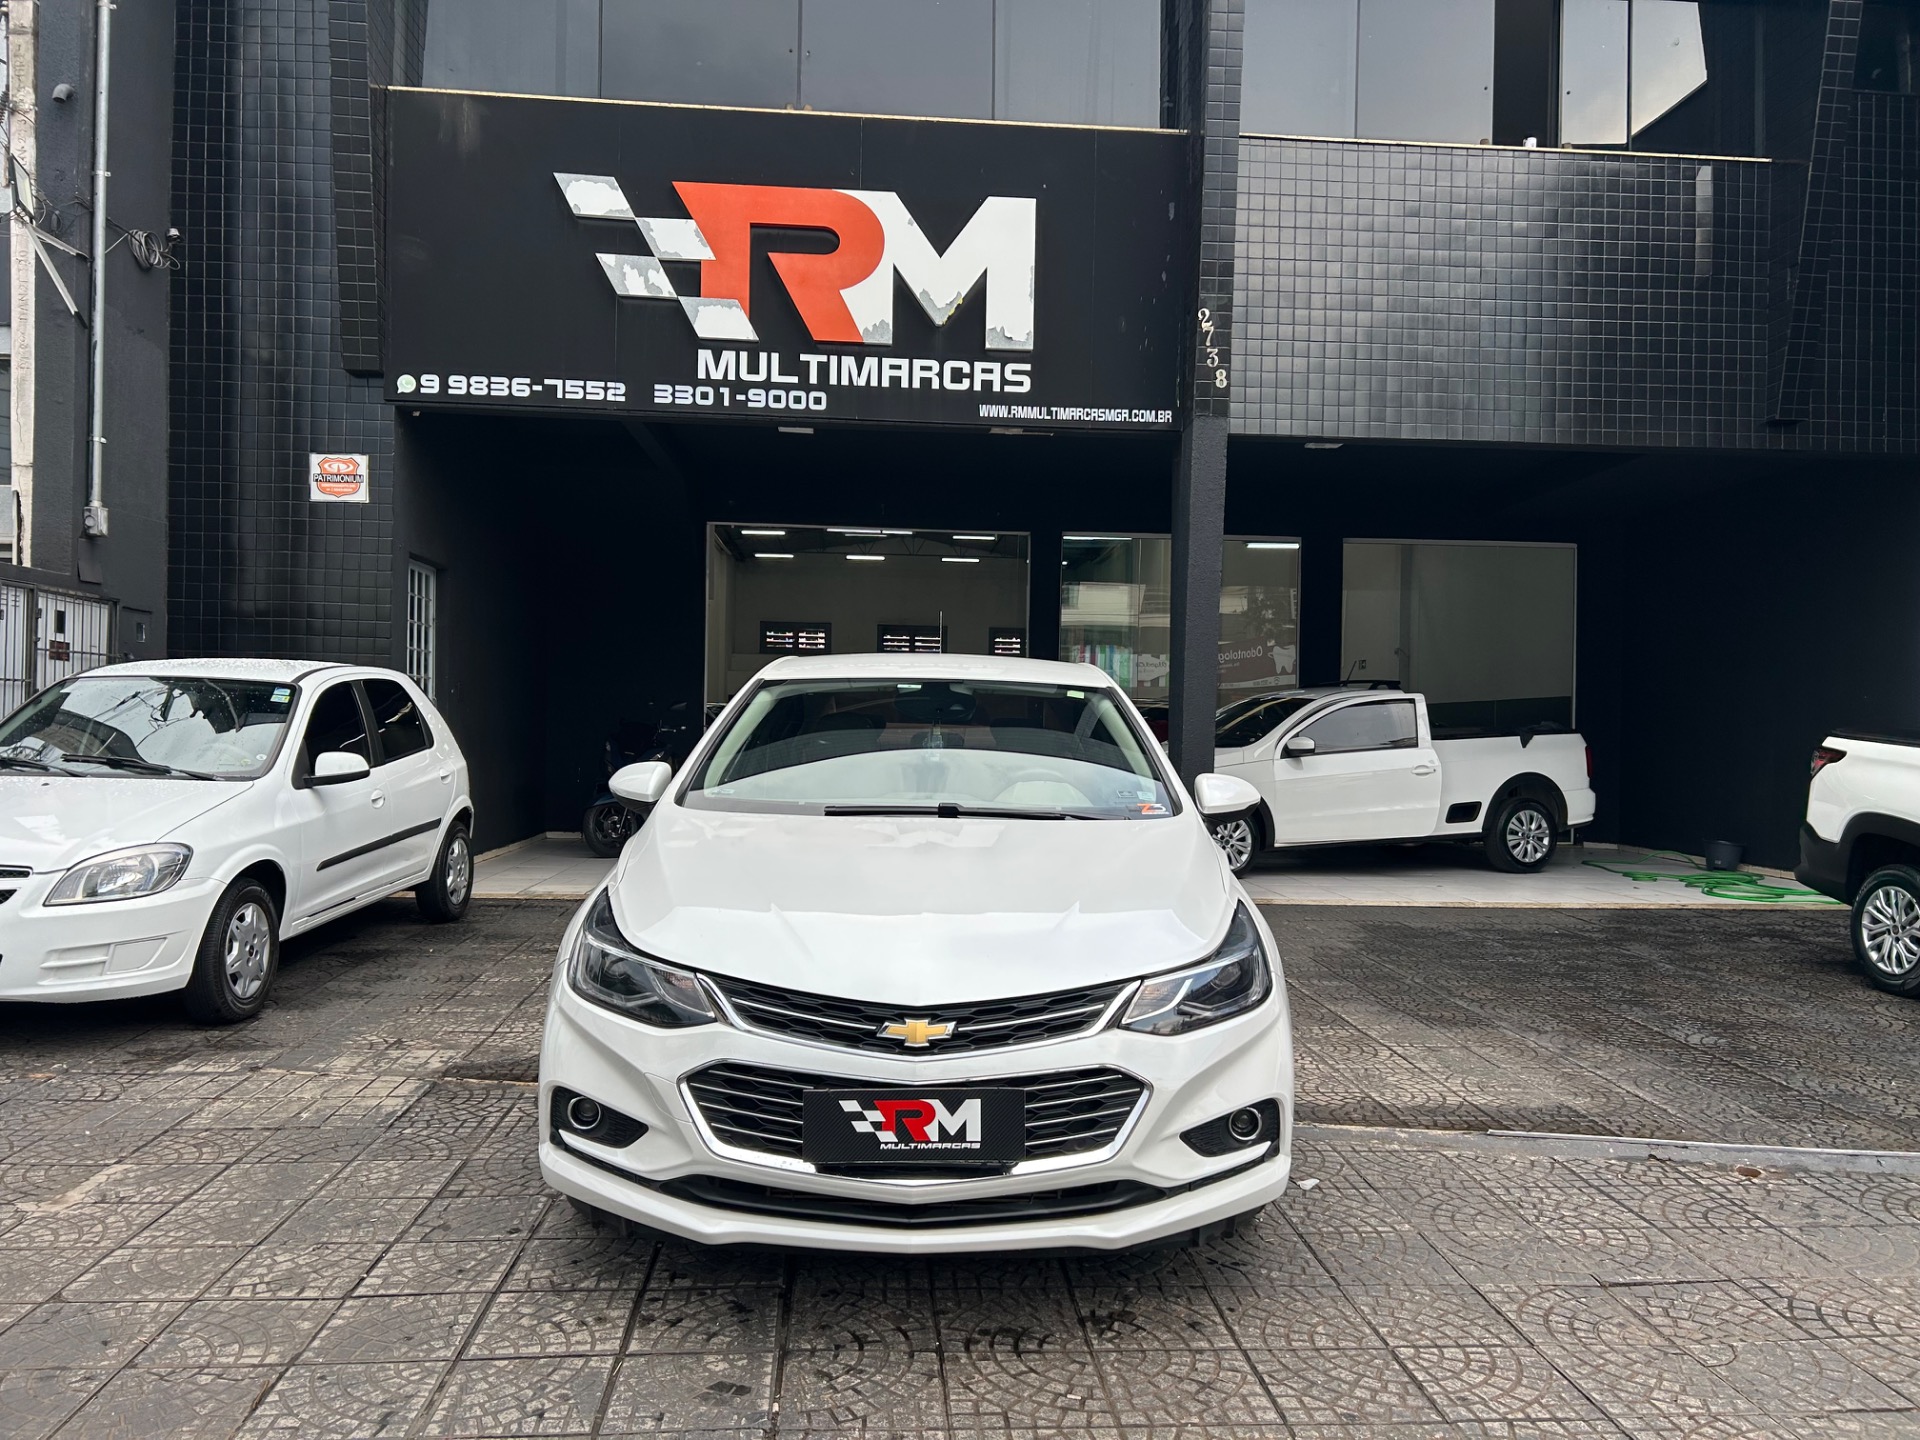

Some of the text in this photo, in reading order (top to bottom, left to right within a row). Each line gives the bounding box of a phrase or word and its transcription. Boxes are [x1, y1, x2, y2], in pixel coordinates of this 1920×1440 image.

[672, 181, 1037, 351] RM
[1197, 307, 1228, 388] 2738
[419, 373, 627, 402] 9 9836-7552
[696, 349, 1032, 393] MULTIMARCAS
[653, 383, 827, 411] 3301-9000
[978, 404, 1173, 423] WWW.RMMULTIMARCASMGA.COM.BR
[313, 474, 364, 483] PATRIMONIUM
[873, 1098, 981, 1142] RM
